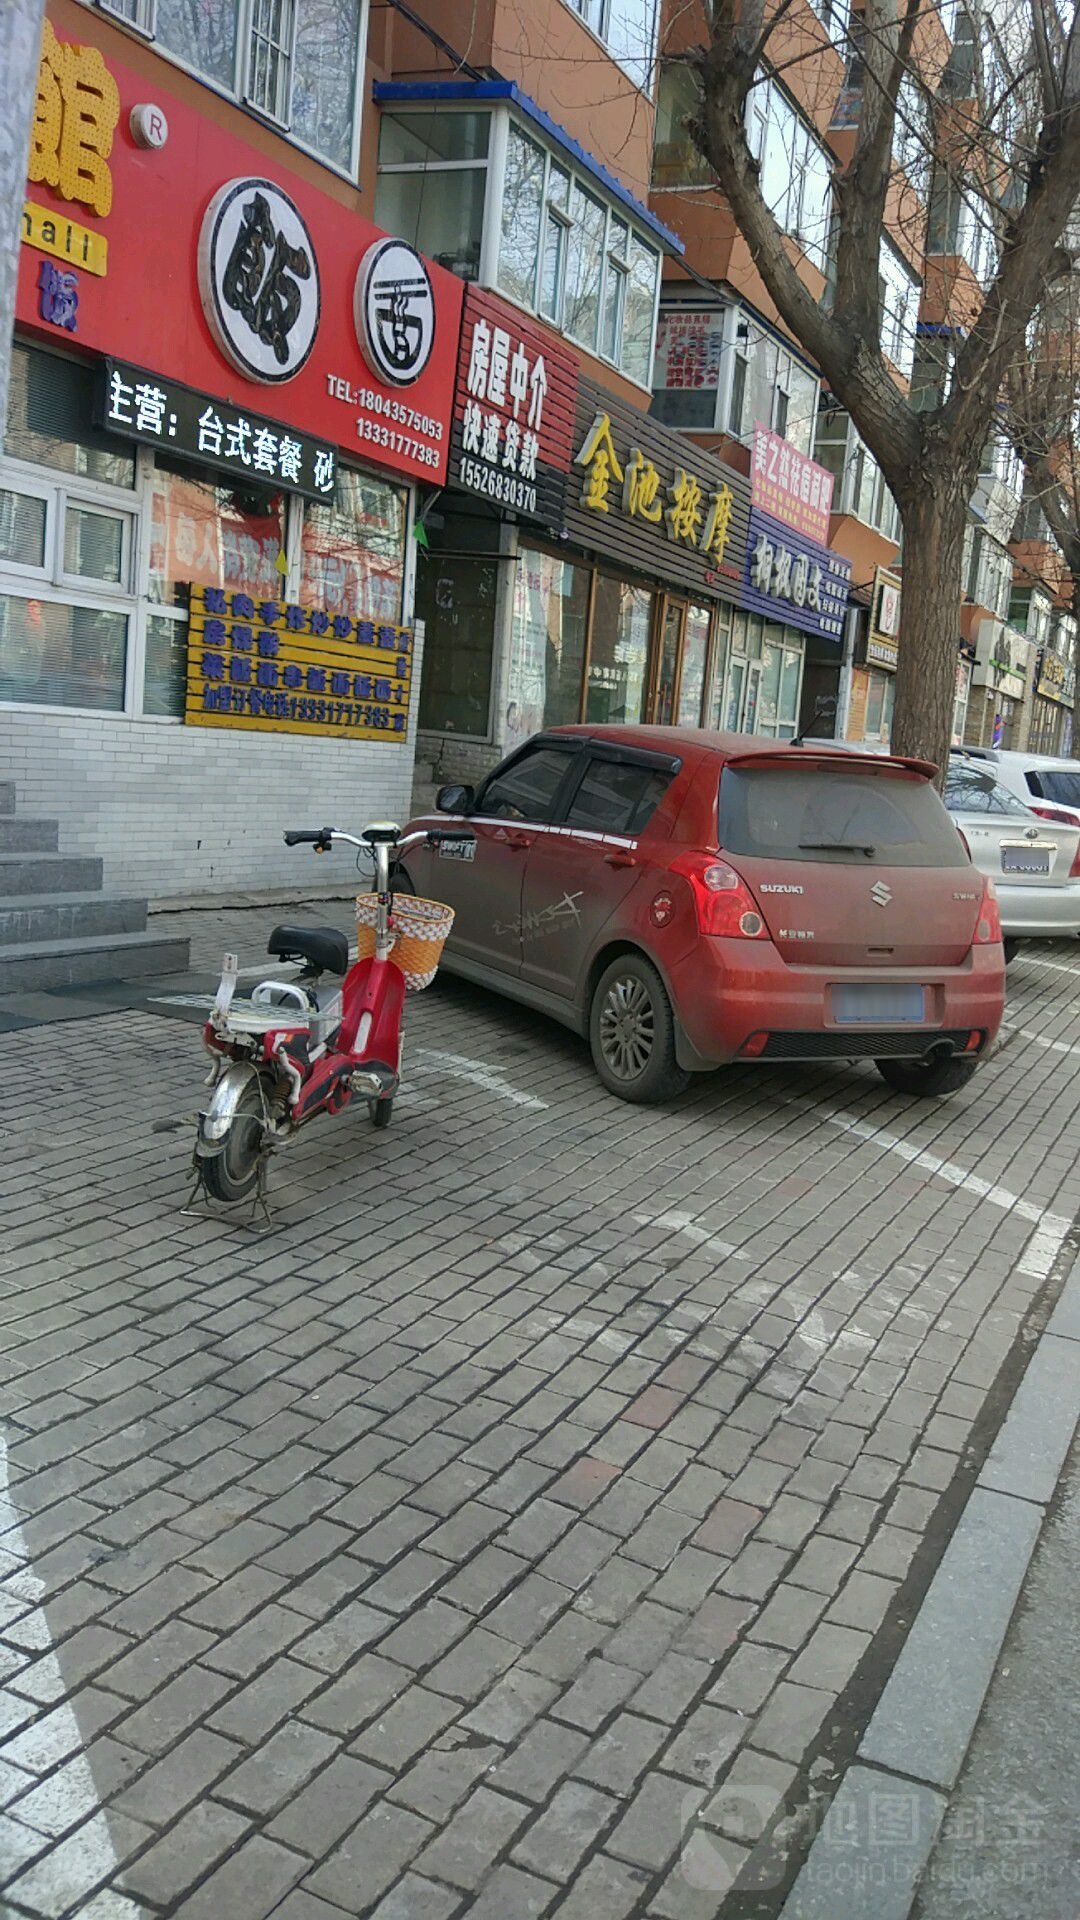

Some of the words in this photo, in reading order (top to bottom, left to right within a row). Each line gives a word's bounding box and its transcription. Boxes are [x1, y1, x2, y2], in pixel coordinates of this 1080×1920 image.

[467, 318, 547, 432] 房屋中介
[197, 406, 304, 484] 台式套餐
[356, 417, 440, 468] 13331777383
[462, 399, 540, 481] 快速贷款
[459, 457, 537, 512] 15526830370
[575, 411, 734, 564] 金池按摩
[760, 884, 804, 895] SUZUKI
